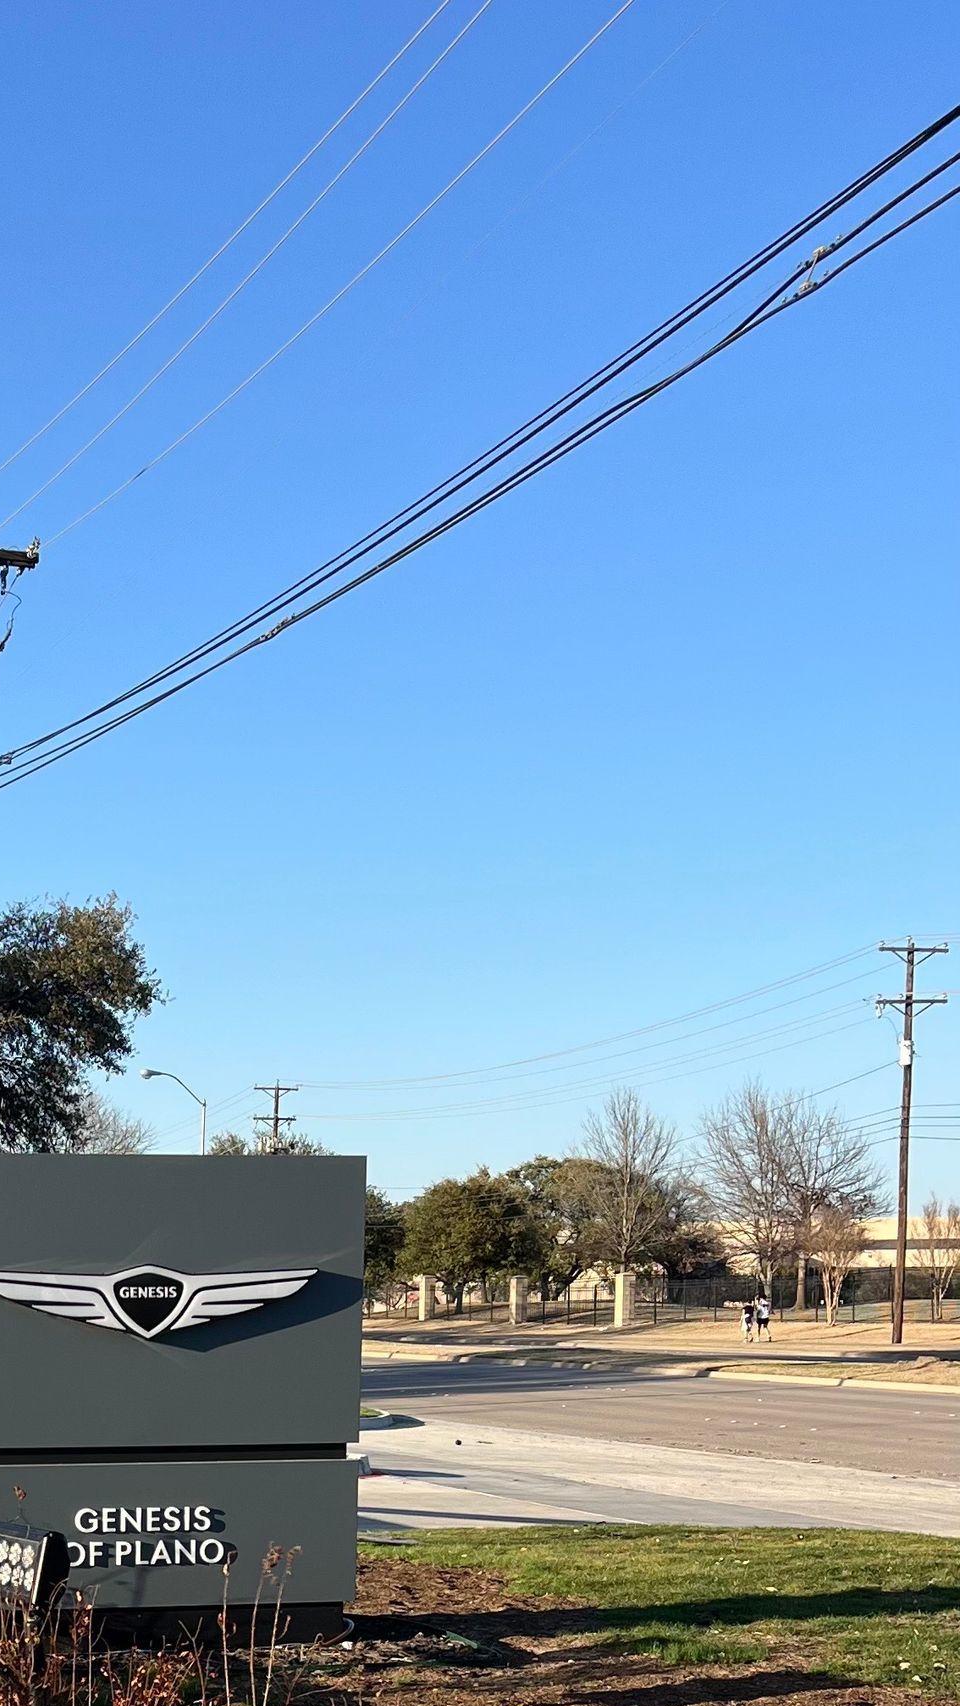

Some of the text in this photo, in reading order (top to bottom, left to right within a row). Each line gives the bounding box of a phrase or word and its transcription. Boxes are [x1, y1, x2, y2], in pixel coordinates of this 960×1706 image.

[119, 1286, 177, 1299] GENESIS
[74, 1505, 211, 1533] GENESIS
[67, 1538, 225, 1567] OF PLANO
